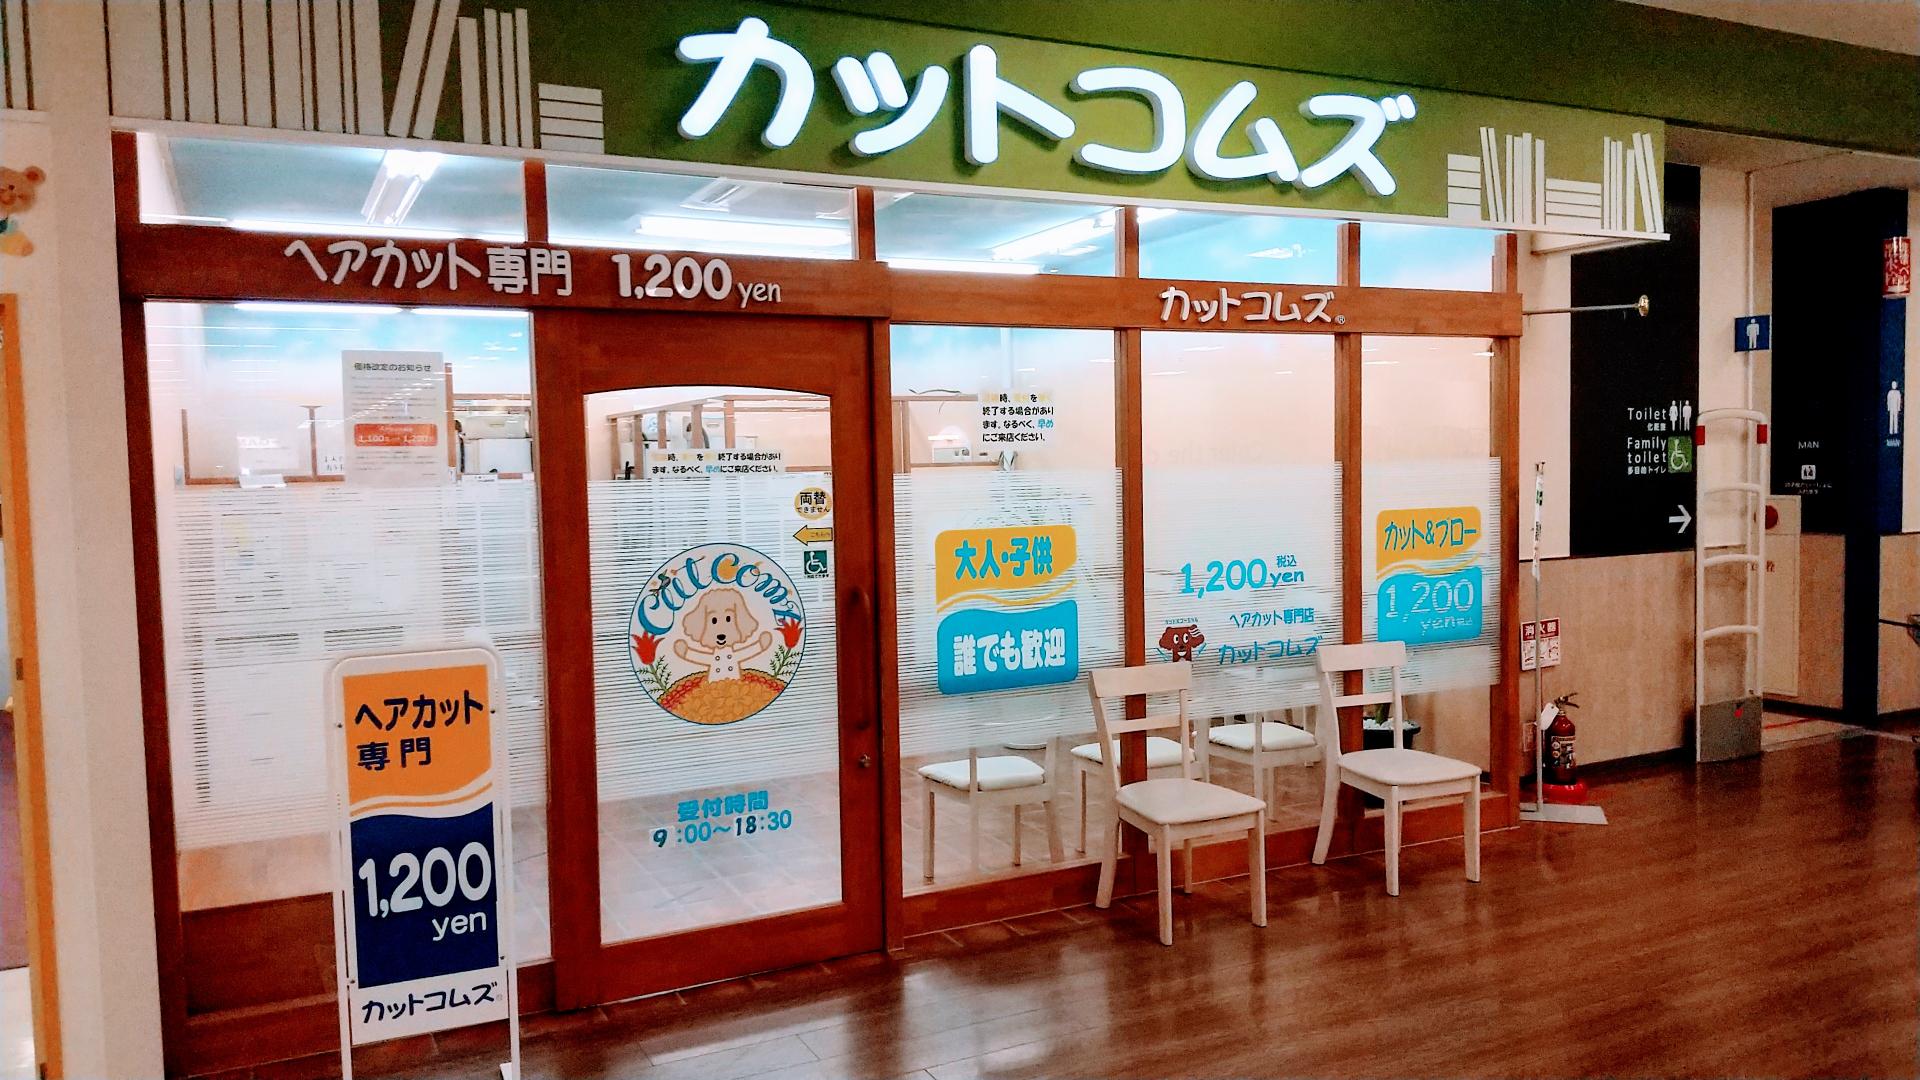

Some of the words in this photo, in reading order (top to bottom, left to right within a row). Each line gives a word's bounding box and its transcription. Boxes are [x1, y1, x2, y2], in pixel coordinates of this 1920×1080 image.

[676, 16, 1417, 197] カットコムズ
[284, 239, 573, 297] ヘアカット専門
[611, 253, 733, 300] 1,200
[737, 281, 782, 308] yen
[1159, 286, 1334, 324] カットコムズ
[982, 406, 1054, 416] 終了する場合があり
[1627, 406, 1667, 420] Toilet
[982, 432, 1046, 442] にご来店ください。
[1627, 435, 1667, 451] Family
[1798, 441, 1820, 449] MAN
[1627, 450, 1667, 464] toilet
[800, 491, 827, 506] 両替
[955, 535, 1053, 580] 大人・子供
[1276, 554, 1297, 568] 税込
[1180, 558, 1268, 599] 1,200
[1269, 569, 1305, 588] yen
[1385, 578, 1474, 623] 1,200
[1229, 607, 1315, 629] ヘアカット専門店
[953, 627, 1066, 677] 誰でも歓迎
[1218, 635, 1323, 665] カットコムズ
[355, 689, 484, 732] ヘアカット
[356, 736, 432, 772] 専門
[677, 790, 769, 823] 受付時間
[358, 841, 492, 918] 1,200
[432, 911, 487, 942] yen
[361, 980, 498, 1024] カットコムズ
